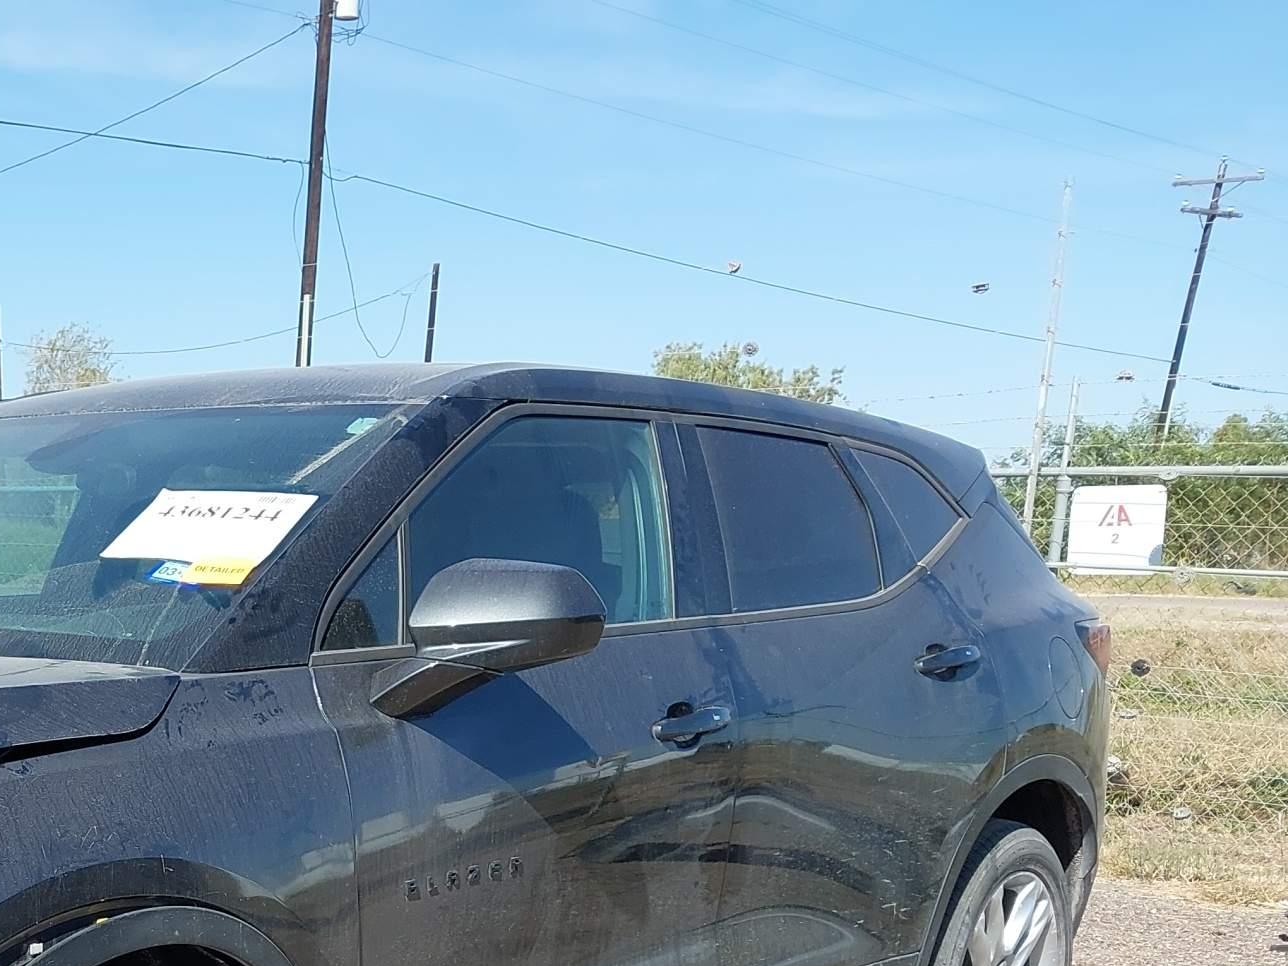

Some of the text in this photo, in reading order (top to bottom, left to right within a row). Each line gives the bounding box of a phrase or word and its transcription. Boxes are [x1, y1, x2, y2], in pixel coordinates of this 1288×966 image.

[158, 505, 283, 521] 43681244
[1111, 533, 1120, 544] 2
[194, 565, 245, 575] DETAILED
[403, 856, 523, 902] BLAZER
